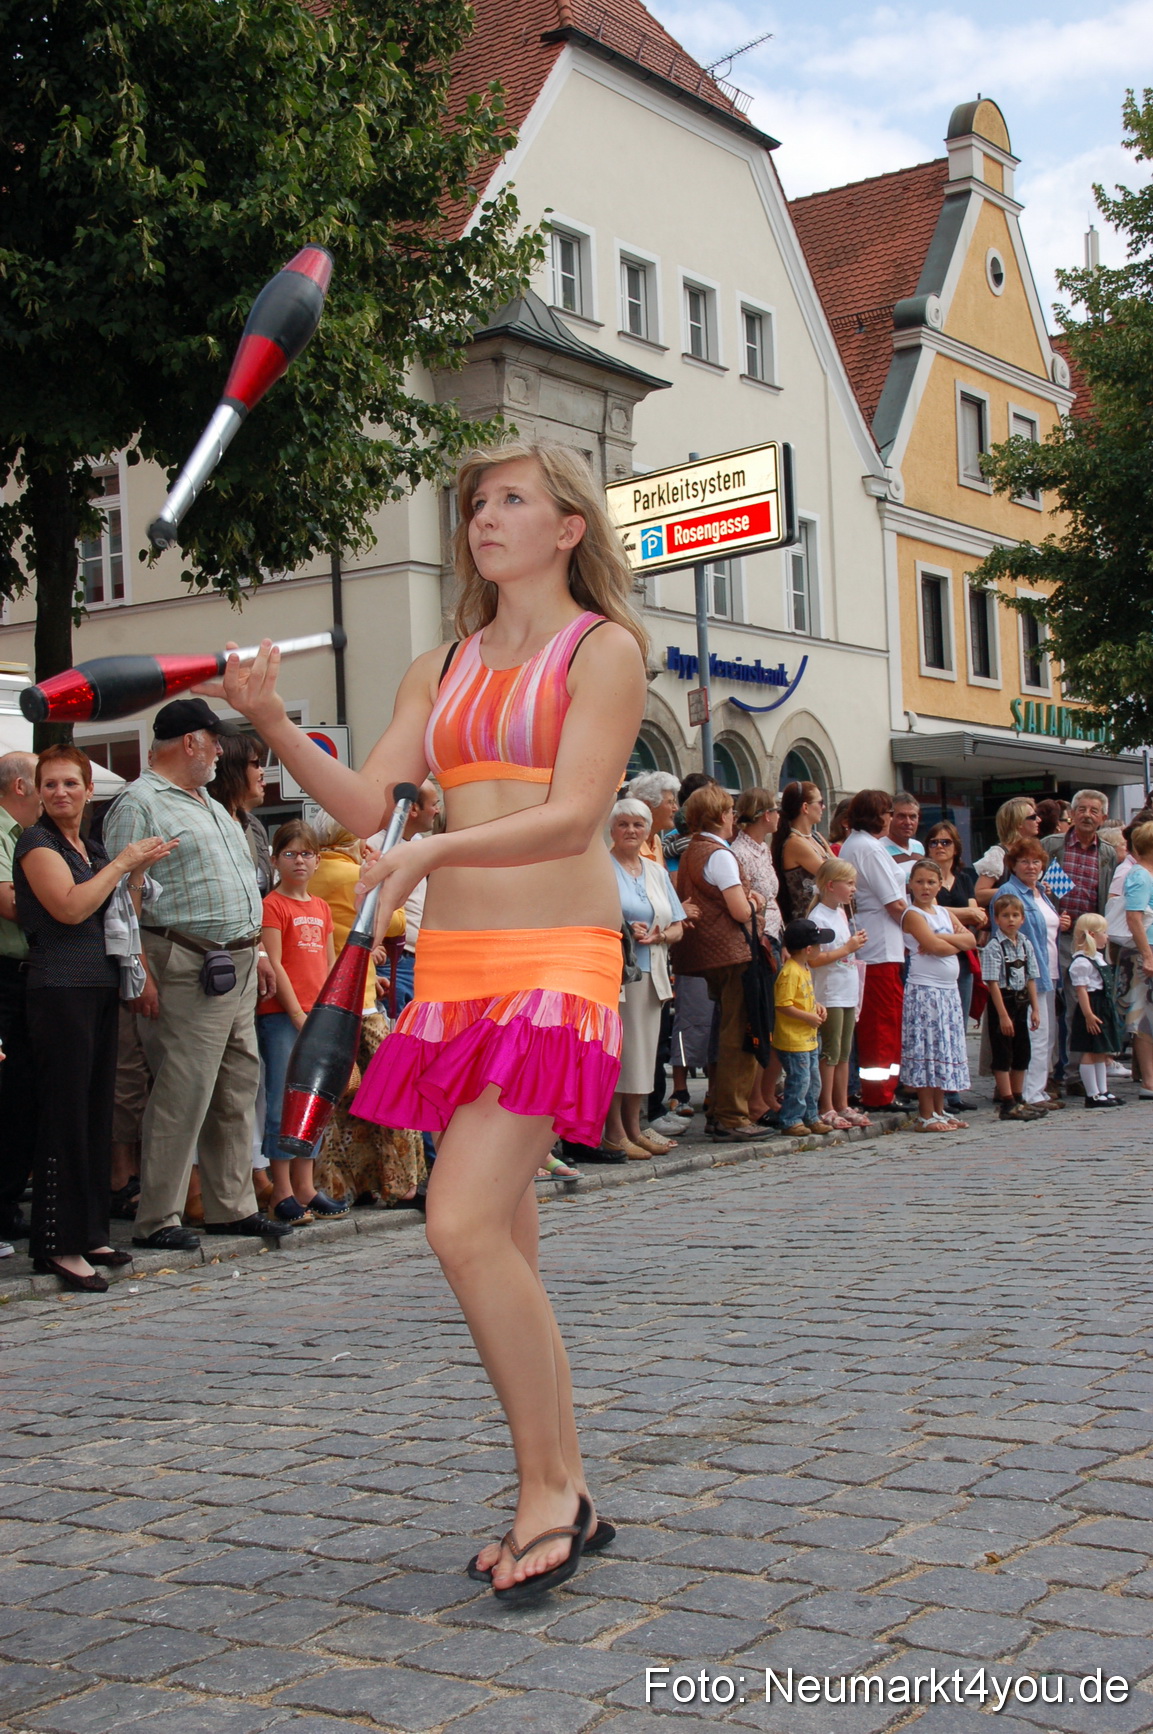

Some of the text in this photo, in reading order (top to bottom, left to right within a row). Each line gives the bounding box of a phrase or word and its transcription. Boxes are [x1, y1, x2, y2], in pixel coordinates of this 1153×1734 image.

[633, 469, 746, 513] Parkleitsystem
[673, 514, 750, 546] Rosengasse
[666, 646, 790, 687] HypVereinsbank
